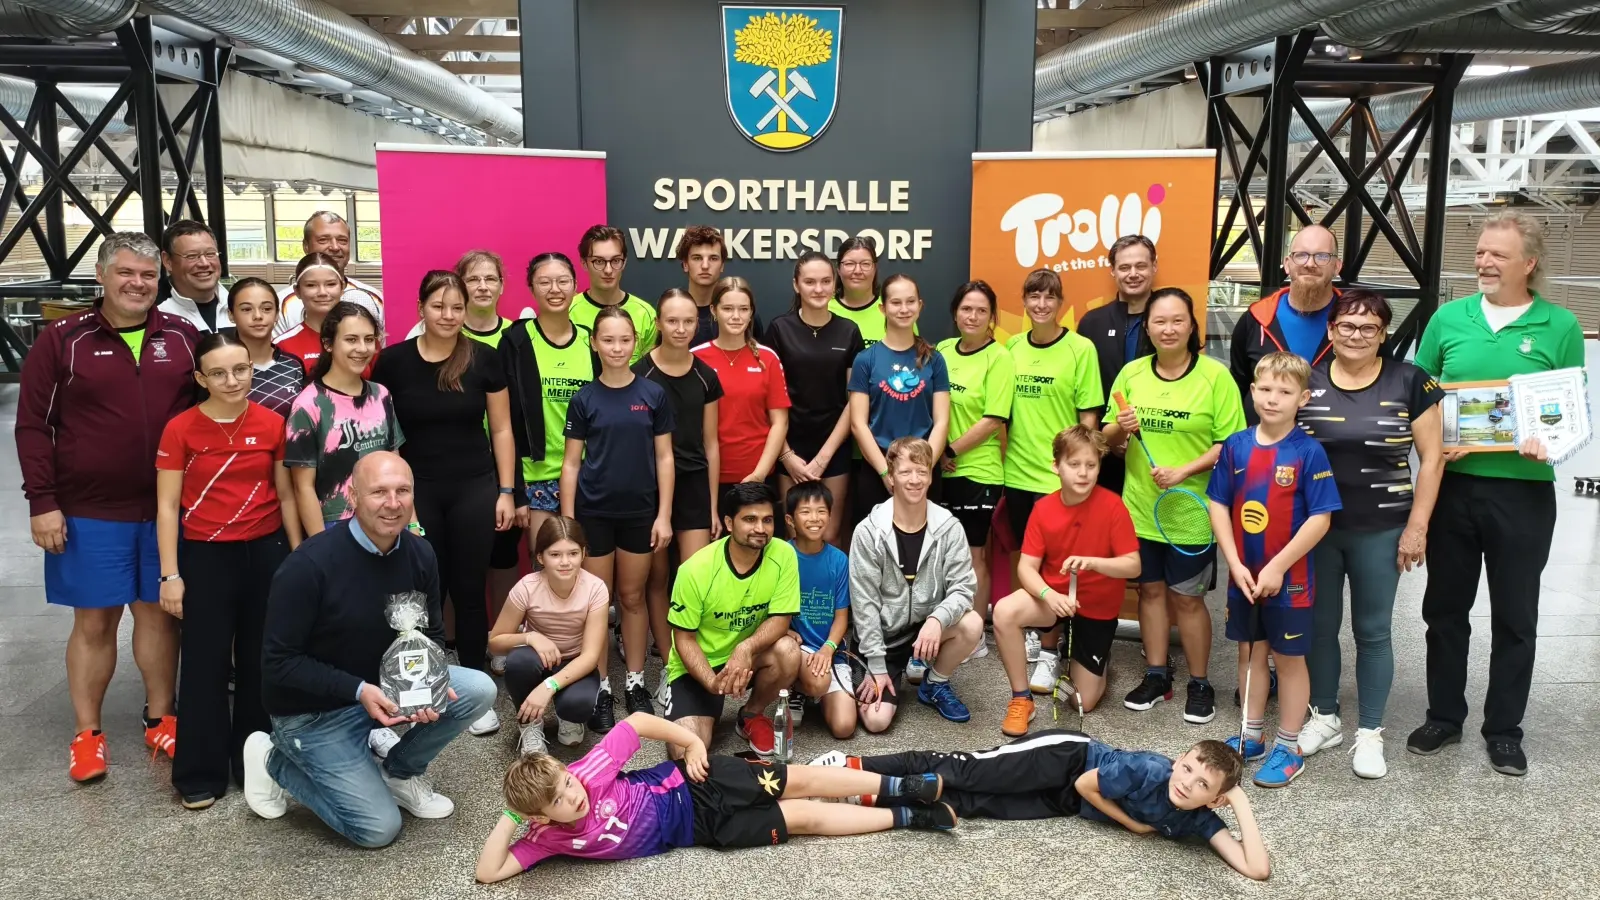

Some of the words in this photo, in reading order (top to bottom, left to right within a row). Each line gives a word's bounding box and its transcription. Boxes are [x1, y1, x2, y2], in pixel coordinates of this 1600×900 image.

[653, 178, 910, 211] SPORTHALLE
[1000, 183, 1166, 268] Trolli
[628, 227, 933, 260] WAKERSDORF
[1070, 257, 1096, 271] the
[879, 380, 909, 402] SUMMER
[909, 379, 927, 399] CAMP
[1016, 384, 1042, 394] MEIER
[1137, 407, 1190, 420] INTERSPORT
[1140, 418, 1174, 429] MEIER
[245, 437, 257, 445] FZ
[353, 438, 386, 452] Couture
[729, 614, 756, 628] MEIER
